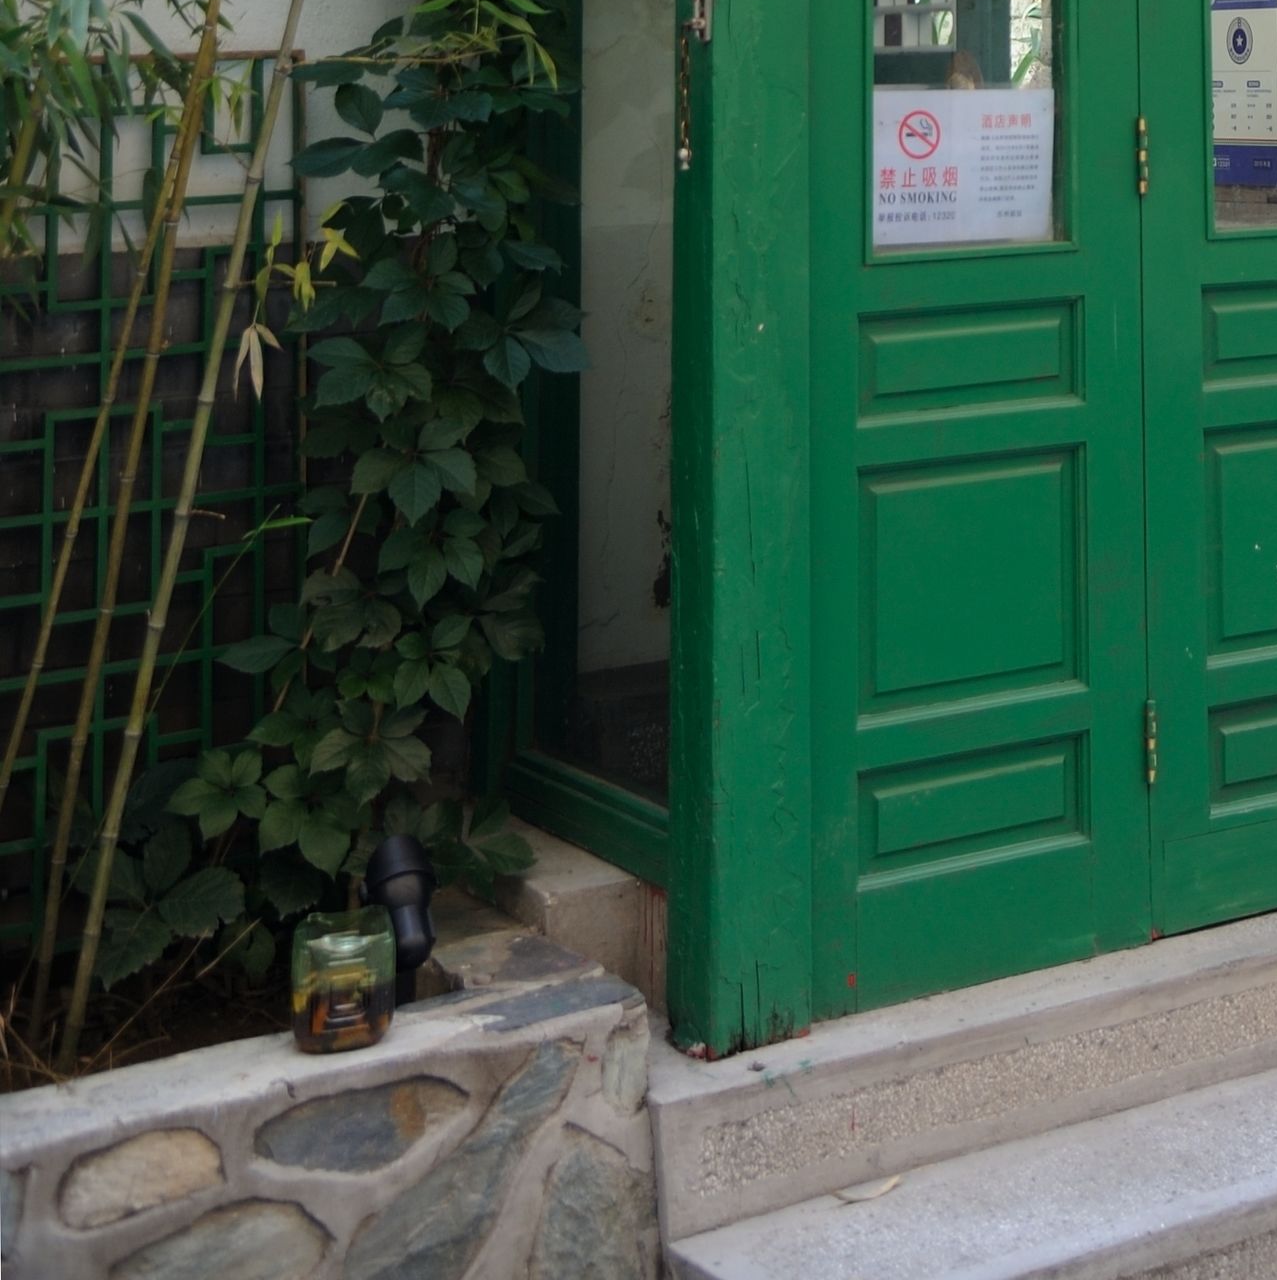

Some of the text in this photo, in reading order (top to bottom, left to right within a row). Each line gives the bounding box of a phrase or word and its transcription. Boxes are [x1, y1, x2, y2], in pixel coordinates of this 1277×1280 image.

[879, 166, 959, 190] 禁止吸烟
[879, 191, 957, 206] NO SMOKING
